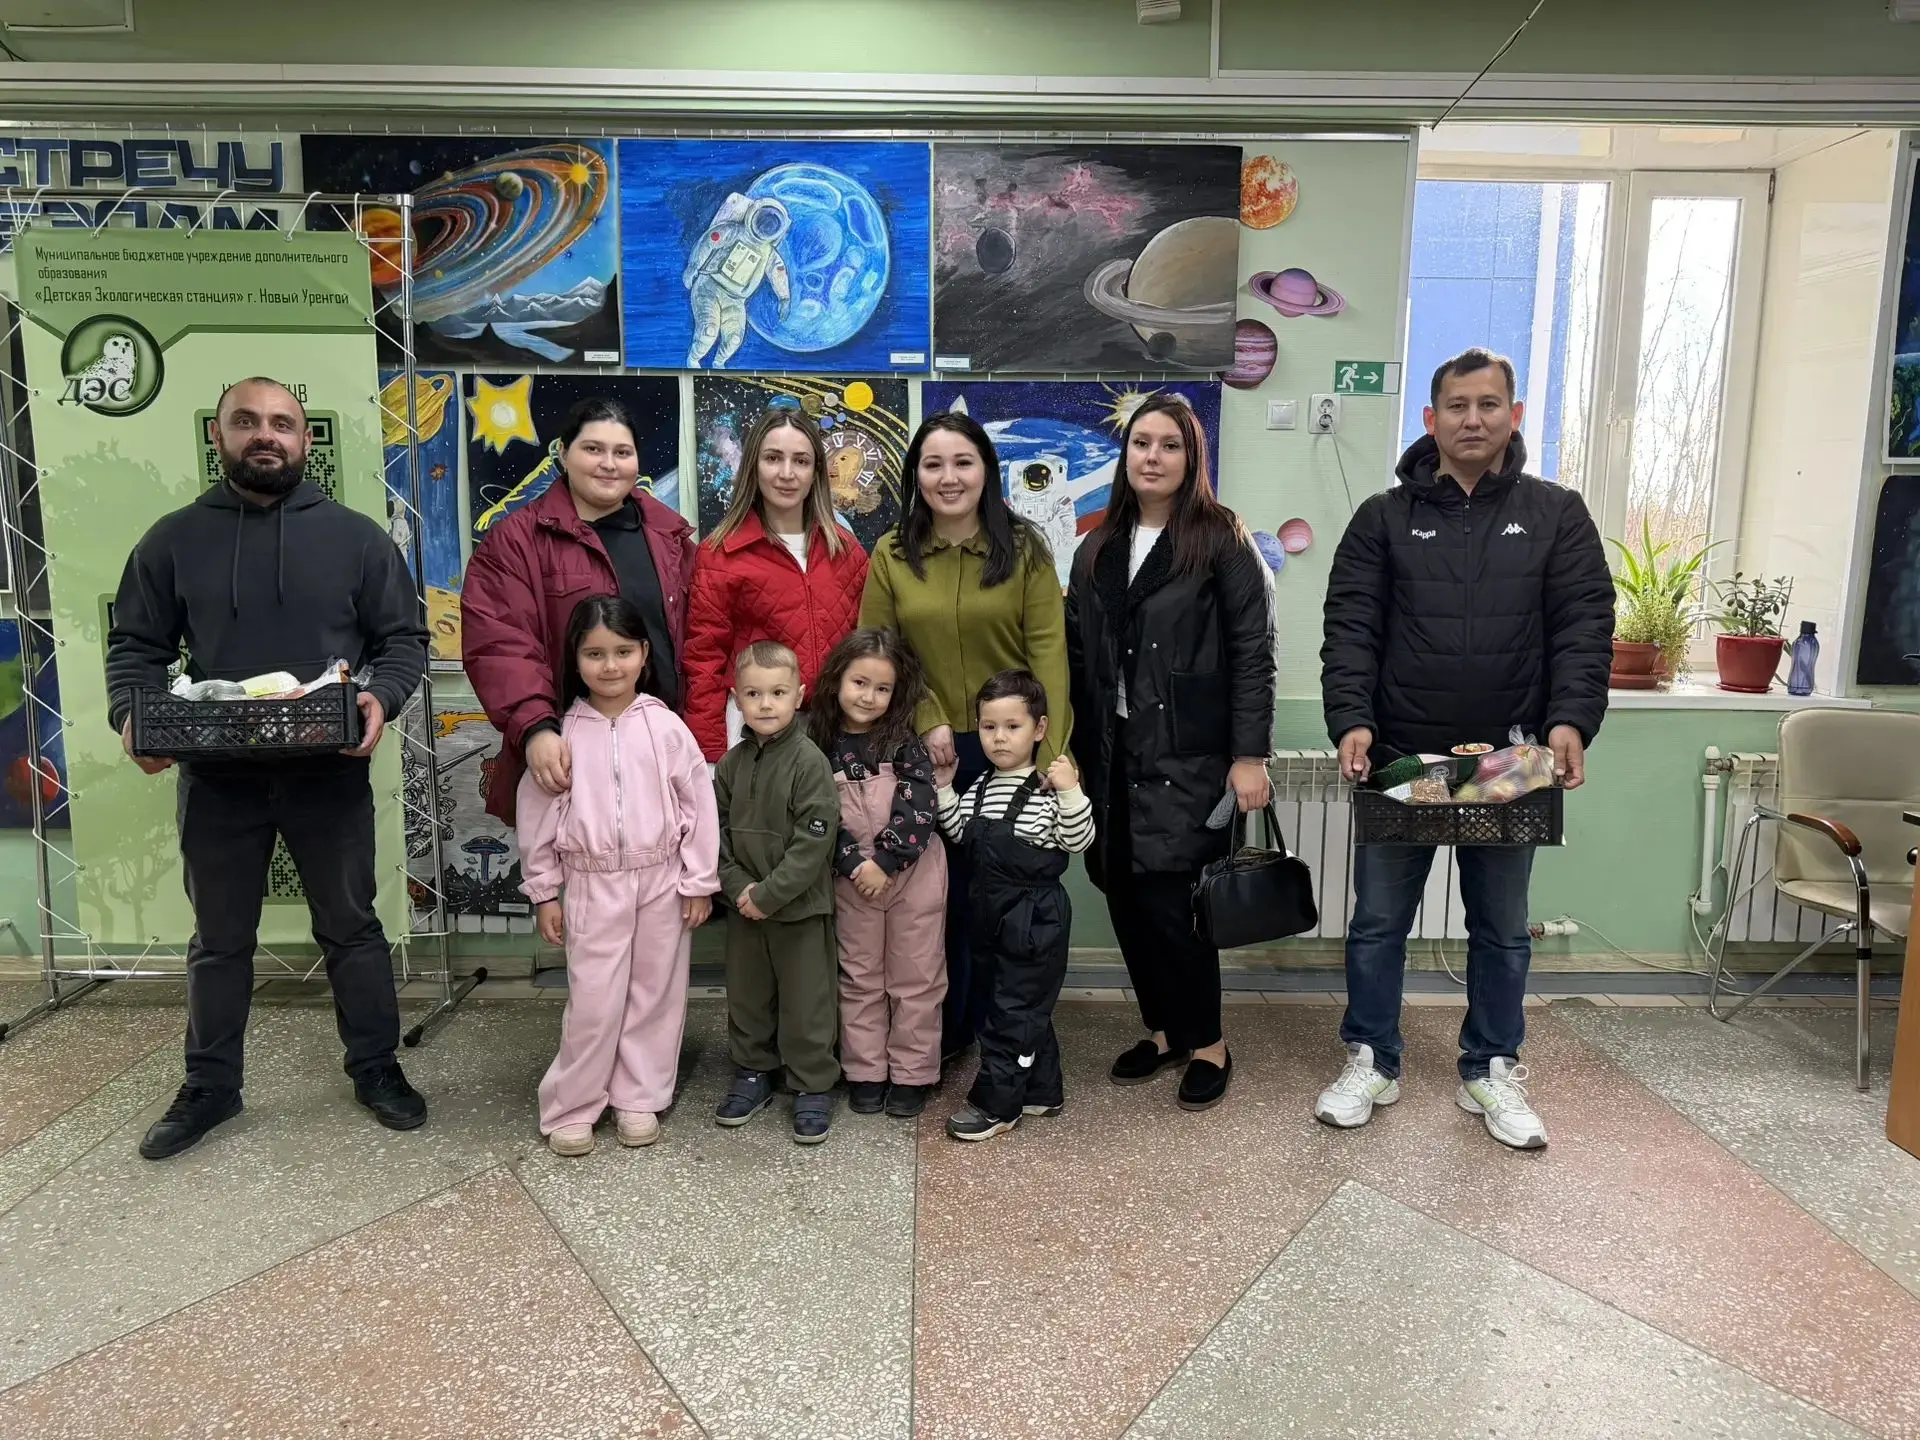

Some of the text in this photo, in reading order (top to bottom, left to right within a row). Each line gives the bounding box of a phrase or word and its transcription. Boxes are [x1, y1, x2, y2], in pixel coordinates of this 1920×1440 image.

[35, 246, 349, 264] Муниципальное бюджетное учреждение дополнительного
[38, 267, 108, 281] образования
[35, 286, 349, 307] «Детская Экологическая станция» г. Новый Уренгой
[57, 377, 131, 407] ДЭС
[1411, 529, 1436, 540] Kappa
